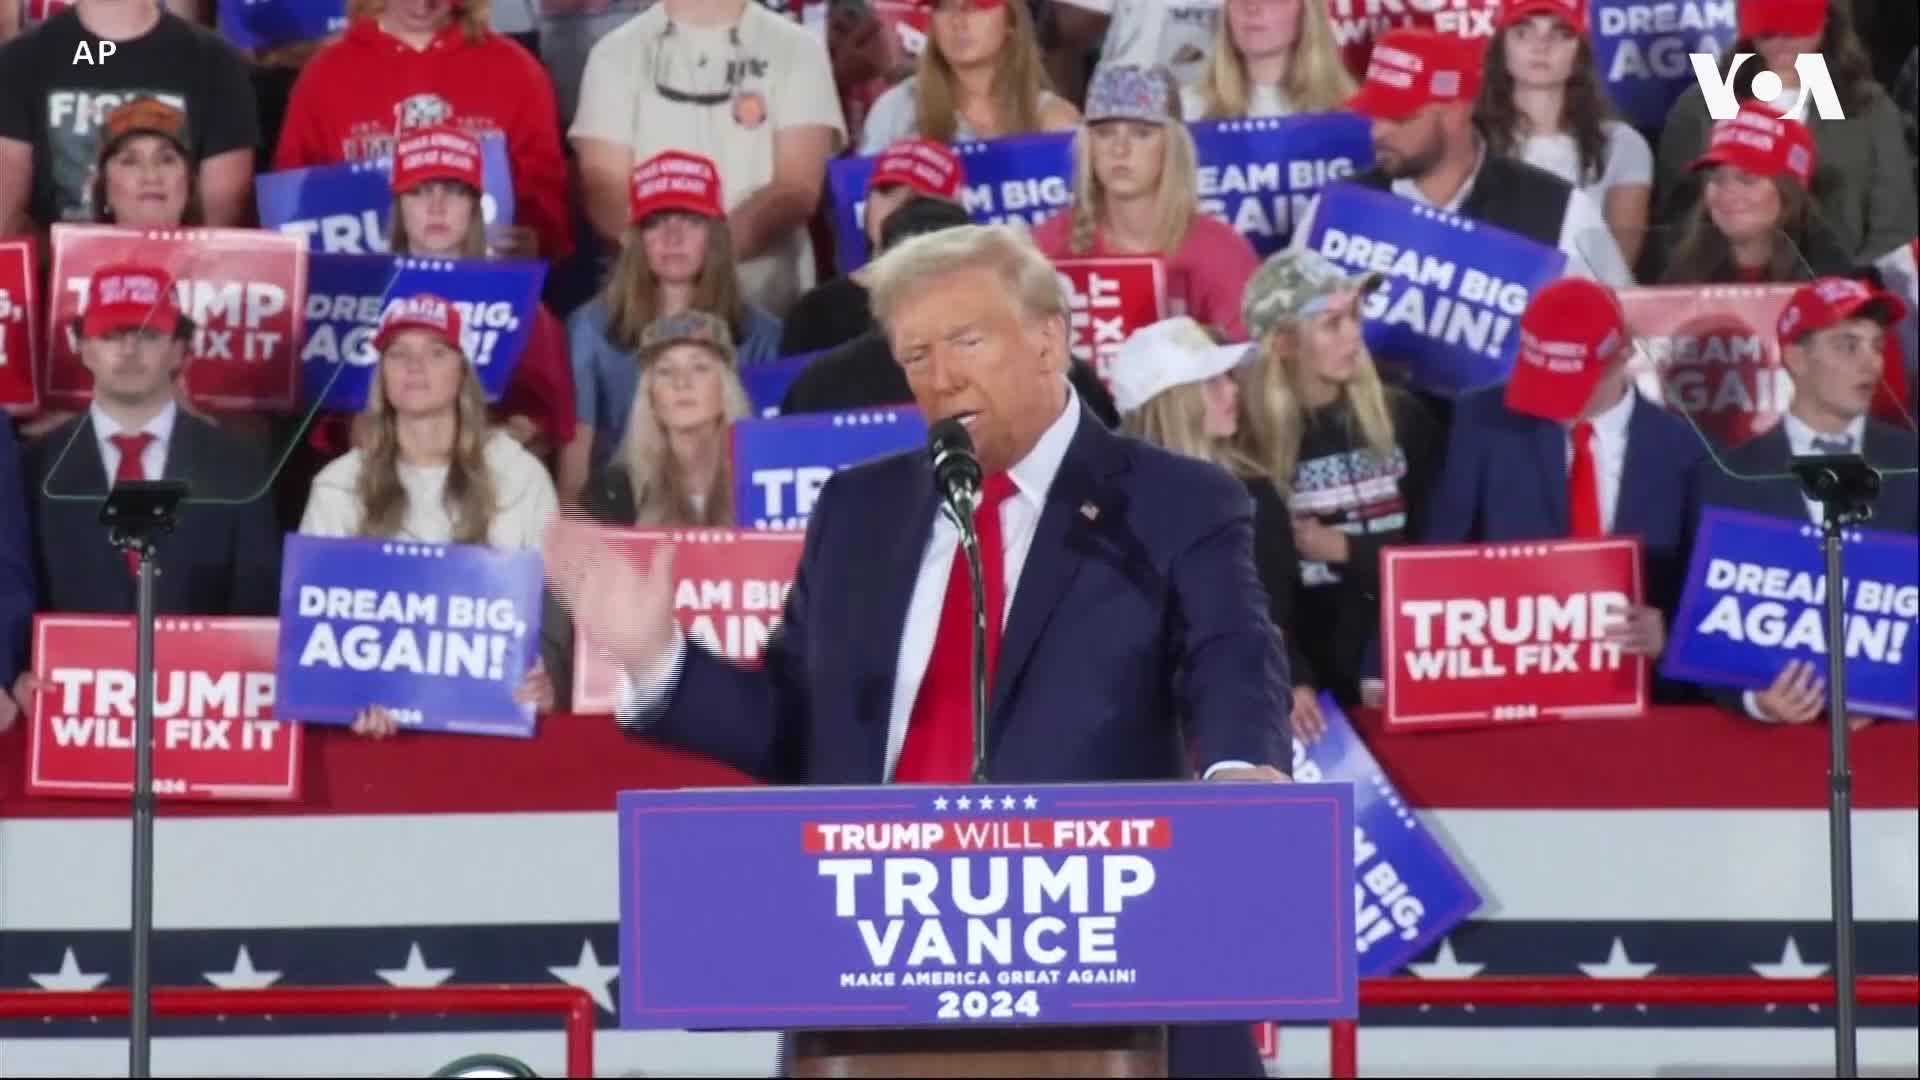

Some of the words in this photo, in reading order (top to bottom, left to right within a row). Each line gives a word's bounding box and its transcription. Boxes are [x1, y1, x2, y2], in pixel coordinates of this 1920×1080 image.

[1434, 9, 1494, 38] FIX
[1599, 1, 1736, 36] DREAM
[1321, 228, 1456, 290] DREAM
[243, 330, 282, 361] IT
[299, 585, 438, 628] DREAM
[447, 594, 527, 638] BIG,
[300, 622, 509, 680] AGAIN!
[1404, 647, 1507, 682] WILL
[1515, 640, 1580, 676] FIX
[1589, 638, 1622, 671] IT
[165, 718, 232, 750] FIX
[241, 721, 281, 751] IT
[817, 823, 945, 852] TRUMP
[953, 819, 1043, 849] WILL
[1052, 818, 1112, 849] FIX
[1121, 818, 1156, 848] IT
[817, 854, 1157, 918] TRUMP
[856, 915, 1118, 967] VANCE
[840, 972, 895, 987] MAKE
[901, 970, 991, 987] AMERICA
[996, 969, 1060, 986] GREAT
[1067, 968, 1137, 985] AGAIN!
[936, 990, 1040, 1019] 2024
